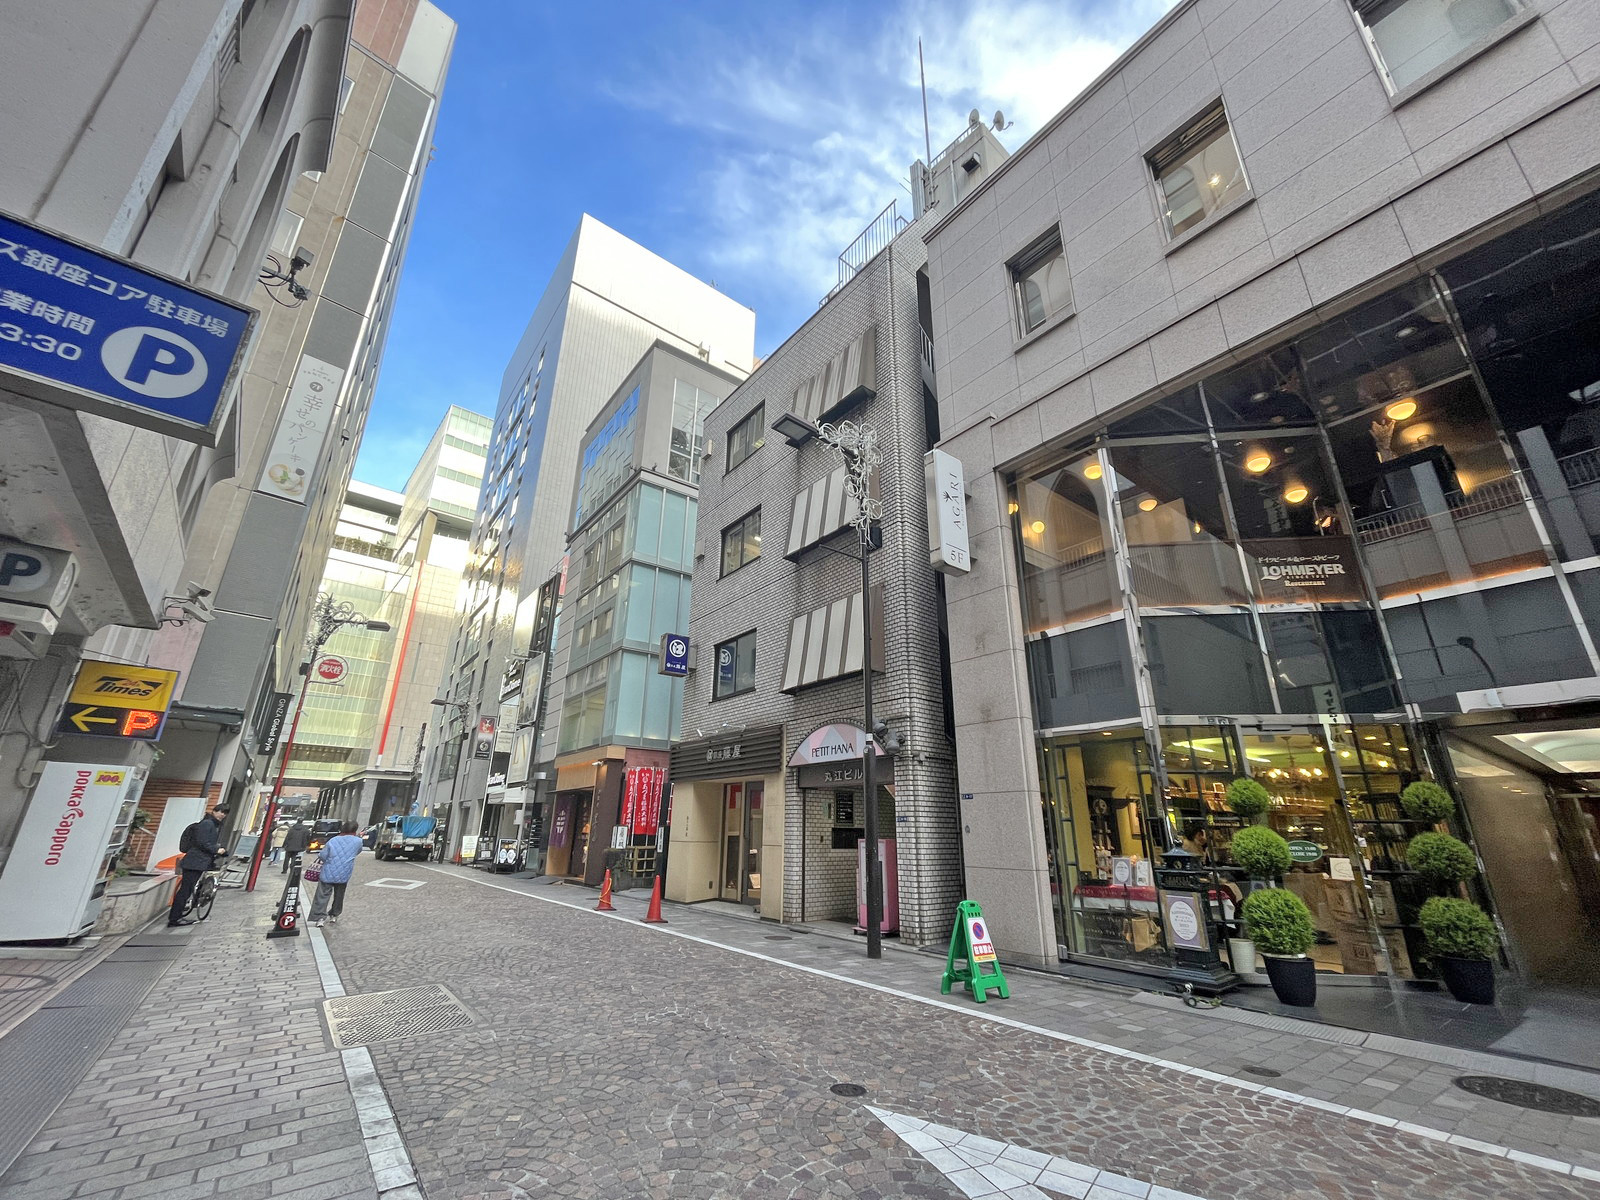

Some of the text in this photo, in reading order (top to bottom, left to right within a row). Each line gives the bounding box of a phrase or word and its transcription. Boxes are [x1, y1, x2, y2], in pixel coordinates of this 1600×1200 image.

[0, 288, 96, 336] 業時間
[124, 333, 195, 385] P
[287, 393, 324, 463] 幸せのパンケーキ
[949, 472, 962, 530] AGARI
[0, 552, 42, 586] P
[950, 550, 964, 564] 5F
[1260, 563, 1346, 581] LOHMEYER
[319, 663, 342, 675] 消火栓
[94, 676, 153, 697] Times
[122, 710, 158, 736] P
[264, 698, 286, 752] GINZA Global Style
[811, 743, 855, 758] PETIT HANA
[824, 767, 863, 783] 丸江ビル
